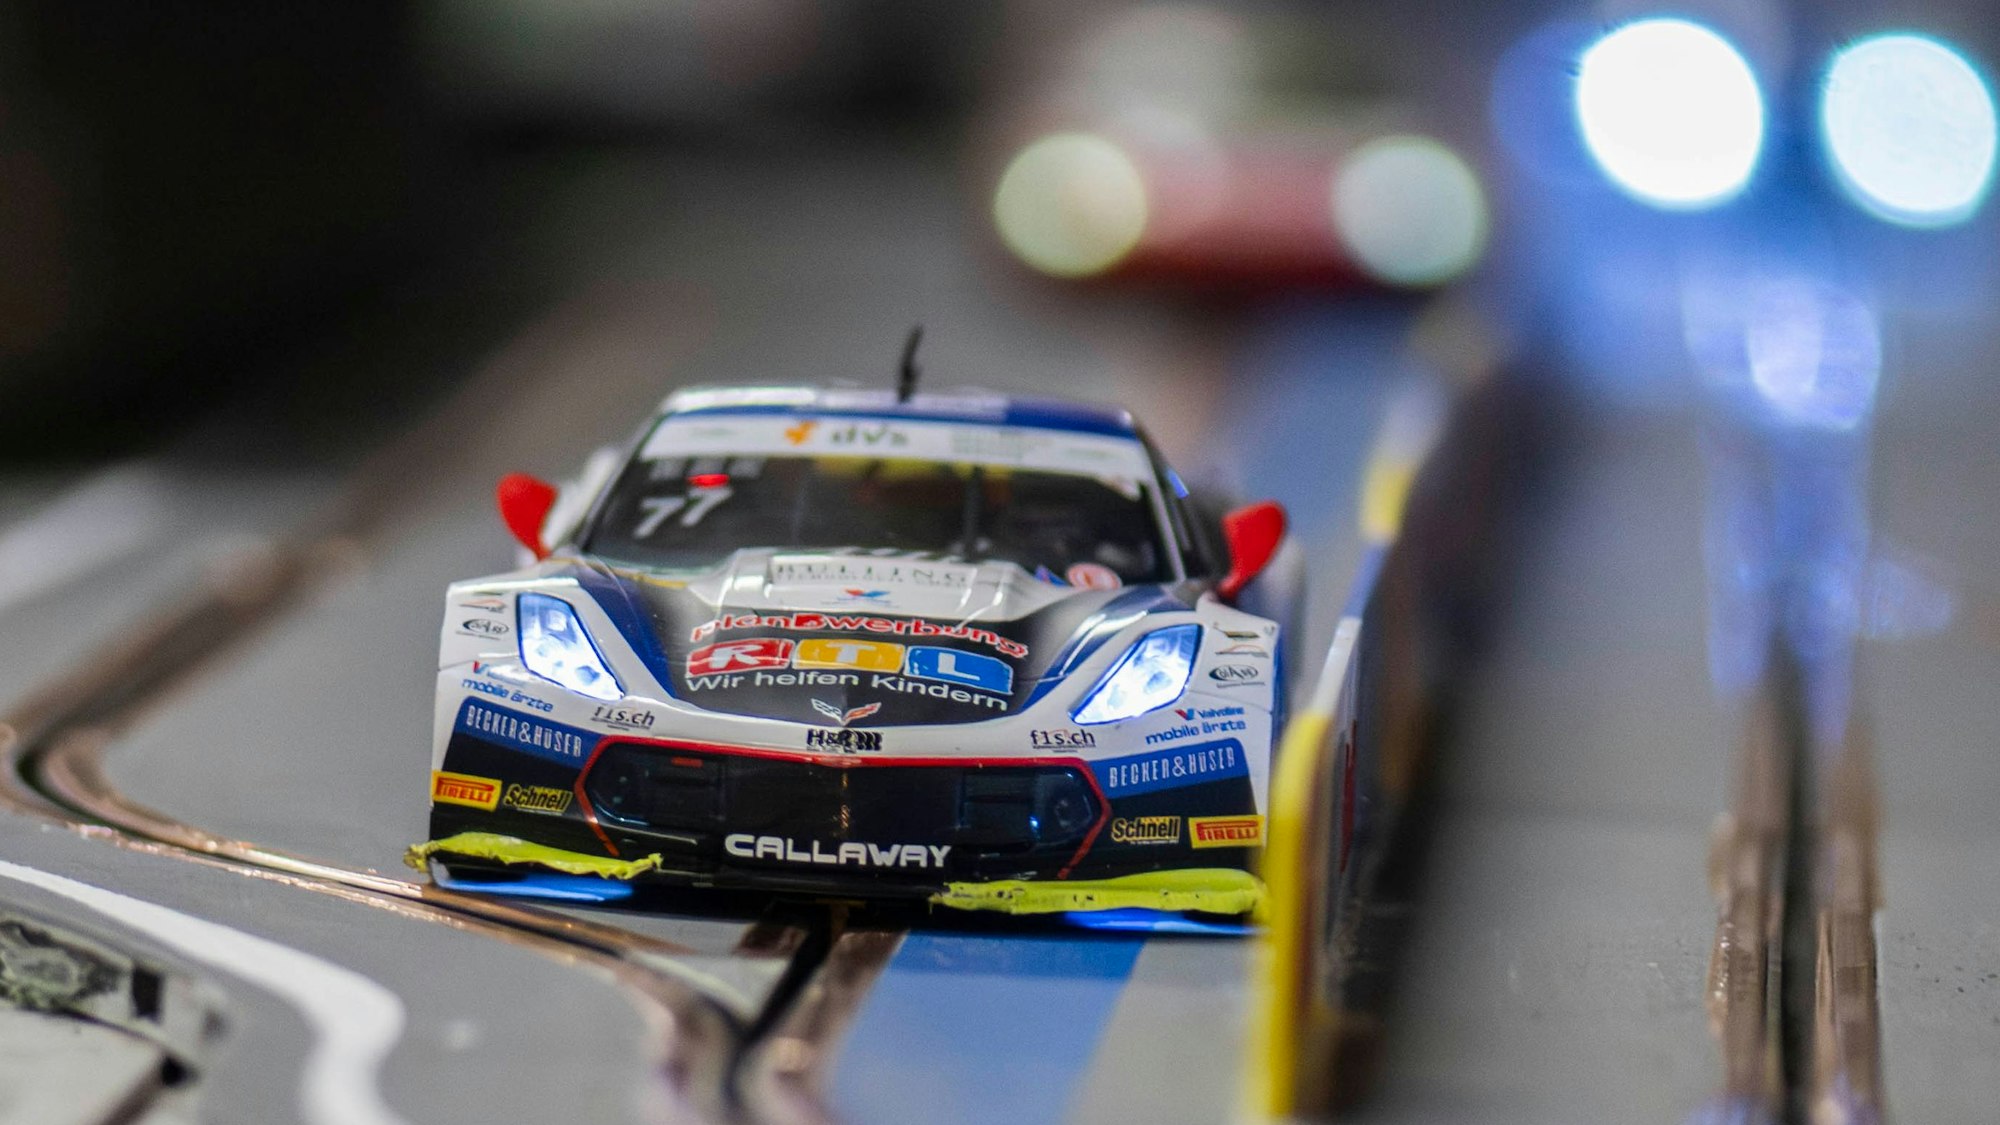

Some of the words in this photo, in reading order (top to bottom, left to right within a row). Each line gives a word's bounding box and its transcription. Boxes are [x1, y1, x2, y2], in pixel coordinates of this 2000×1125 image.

[633, 486, 732, 540] 77
[461, 678, 509, 699] mobile
[510, 690, 554, 712] ärzte
[686, 674, 745, 691] Wir
[754, 671, 859, 687] helfen
[871, 674, 1008, 711] Kindern
[1197, 706, 1245, 720] Valvoline
[1030, 728, 1096, 746] f1s.ch
[1145, 725, 1199, 746] mobile
[1202, 720, 1246, 736] ärzte
[436, 777, 495, 803] PIRELLI
[505, 784, 572, 811] Schnell
[1112, 817, 1179, 839] Schnell
[1195, 820, 1259, 842] PIRELLI
[724, 833, 952, 868] CALLAWAY
